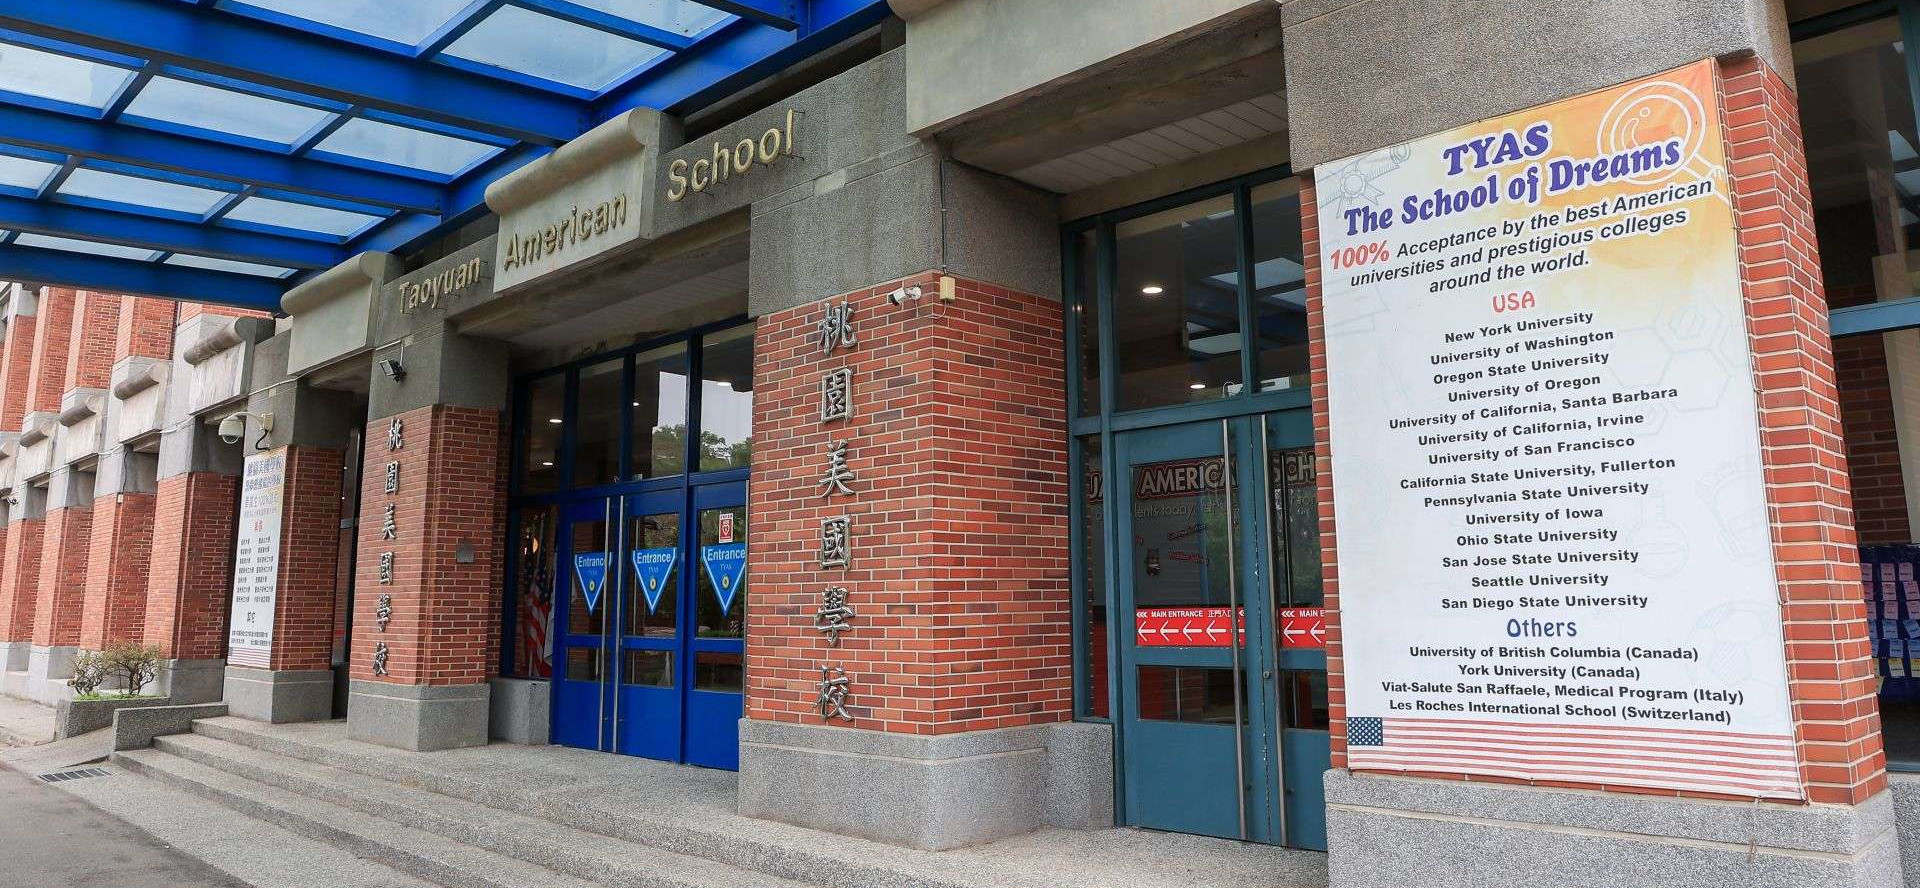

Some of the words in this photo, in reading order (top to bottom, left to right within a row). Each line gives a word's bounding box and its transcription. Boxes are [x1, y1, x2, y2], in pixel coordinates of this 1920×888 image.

[1442, 123, 1549, 176] TYAS
[1342, 204, 1393, 236] The
[1400, 173, 1499, 225] School
[1507, 165, 1539, 204] of
[1548, 140, 1680, 192] Dreams
[398, 256, 481, 313] Taoyuan
[503, 192, 628, 272] American
[667, 108, 797, 202] School
[1329, 238, 1390, 270] 100%
[1395, 225, 1497, 258] Acceptance
[1501, 219, 1525, 238] by
[1529, 212, 1560, 230] the
[1564, 200, 1608, 224] best
[1611, 179, 1712, 214] American
[1349, 258, 1445, 287] universities
[1449, 246, 1483, 268] and
[1486, 228, 1594, 264] prestigious
[1599, 209, 1686, 238] colleges
[1428, 265, 1492, 293] around
[1496, 263, 1525, 280] the
[1529, 248, 1589, 274] world.
[1491, 289, 1535, 313] USA
[1444, 330, 1475, 344] New
[1478, 322, 1512, 337] York
[1515, 311, 1593, 332] University
[1429, 346, 1501, 365] University
[1504, 341, 1520, 354] of
[1523, 330, 1614, 351] Washington
[1432, 369, 1483, 385] Oregon
[1486, 362, 1526, 377] State
[1530, 352, 1609, 371] University
[1447, 384, 1520, 403] University
[1524, 380, 1539, 393] of
[1543, 375, 1601, 390] Oregon
[1388, 412, 1457, 429] University
[1460, 408, 1475, 421] of
[1479, 400, 1557, 419] California,
[1561, 395, 1607, 410] Santa
[1611, 387, 1678, 404] Barbara
[1417, 429, 1488, 446] University
[1492, 425, 1507, 438] of
[1511, 419, 1592, 436] California,
[1596, 414, 1644, 427] Irvine
[1427, 448, 1500, 465] University
[1503, 445, 1519, 458] of
[1523, 443, 1552, 456] San
[1556, 437, 1635, 453] Francisco
[1139, 461, 1238, 495] AMERICA
[1399, 473, 1466, 489] California
[1470, 471, 1509, 484] State
[1513, 463, 1595, 480] University,
[1599, 457, 1676, 473] Fullerton
[1423, 492, 1517, 508] Pennsylvania
[1520, 487, 1562, 501] State
[1566, 481, 1649, 497] University
[815, 300, 859, 722] 桃園美國學校
[1465, 510, 1540, 525] University
[1544, 507, 1560, 520] of
[1564, 507, 1603, 519] Iowa
[373, 418, 403, 676] 桃園美國學校
[1455, 534, 1489, 546] Ohio
[1492, 532, 1533, 545] State
[1537, 527, 1618, 542] University
[578, 556, 604, 568] Entranc
[637, 552, 671, 564] Entrance
[707, 548, 746, 562] Entrance
[1441, 556, 1468, 568] San
[1472, 554, 1507, 567] Jose
[1511, 553, 1552, 565] State
[1556, 548, 1639, 563] University
[1470, 574, 1524, 588] Seattle
[1528, 572, 1609, 587] University
[1151, 610, 1167, 618] MAIN
[1168, 610, 1203, 618] ENTRANCE
[1299, 610, 1319, 618] MAIN
[1441, 597, 1468, 609] San
[1471, 596, 1514, 611] Diego
[1518, 595, 1560, 608] State
[1564, 594, 1648, 609] University
[1505, 616, 1577, 638] Others
[1408, 645, 1477, 660] University
[1479, 645, 1494, 657] of
[1497, 645, 1546, 658] British
[1549, 645, 1621, 658] Columbia
[1625, 645, 1698, 662] (Canada)
[1457, 663, 1490, 676] York
[1492, 664, 1567, 680] University
[1570, 665, 1640, 681] (Canada)
[1380, 680, 1453, 693] Viat-Salute
[1456, 681, 1482, 694] San
[1485, 682, 1550, 698] Raffaele,
[1553, 684, 1614, 697] Medical
[1618, 685, 1688, 702] Program
[1692, 687, 1744, 705] (Italy)
[1388, 698, 1412, 711] Les
[1415, 699, 1465, 712] Roches
[1467, 700, 1560, 715] International
[1563, 703, 1617, 717] School
[1620, 705, 1731, 726] (Switzerland)
